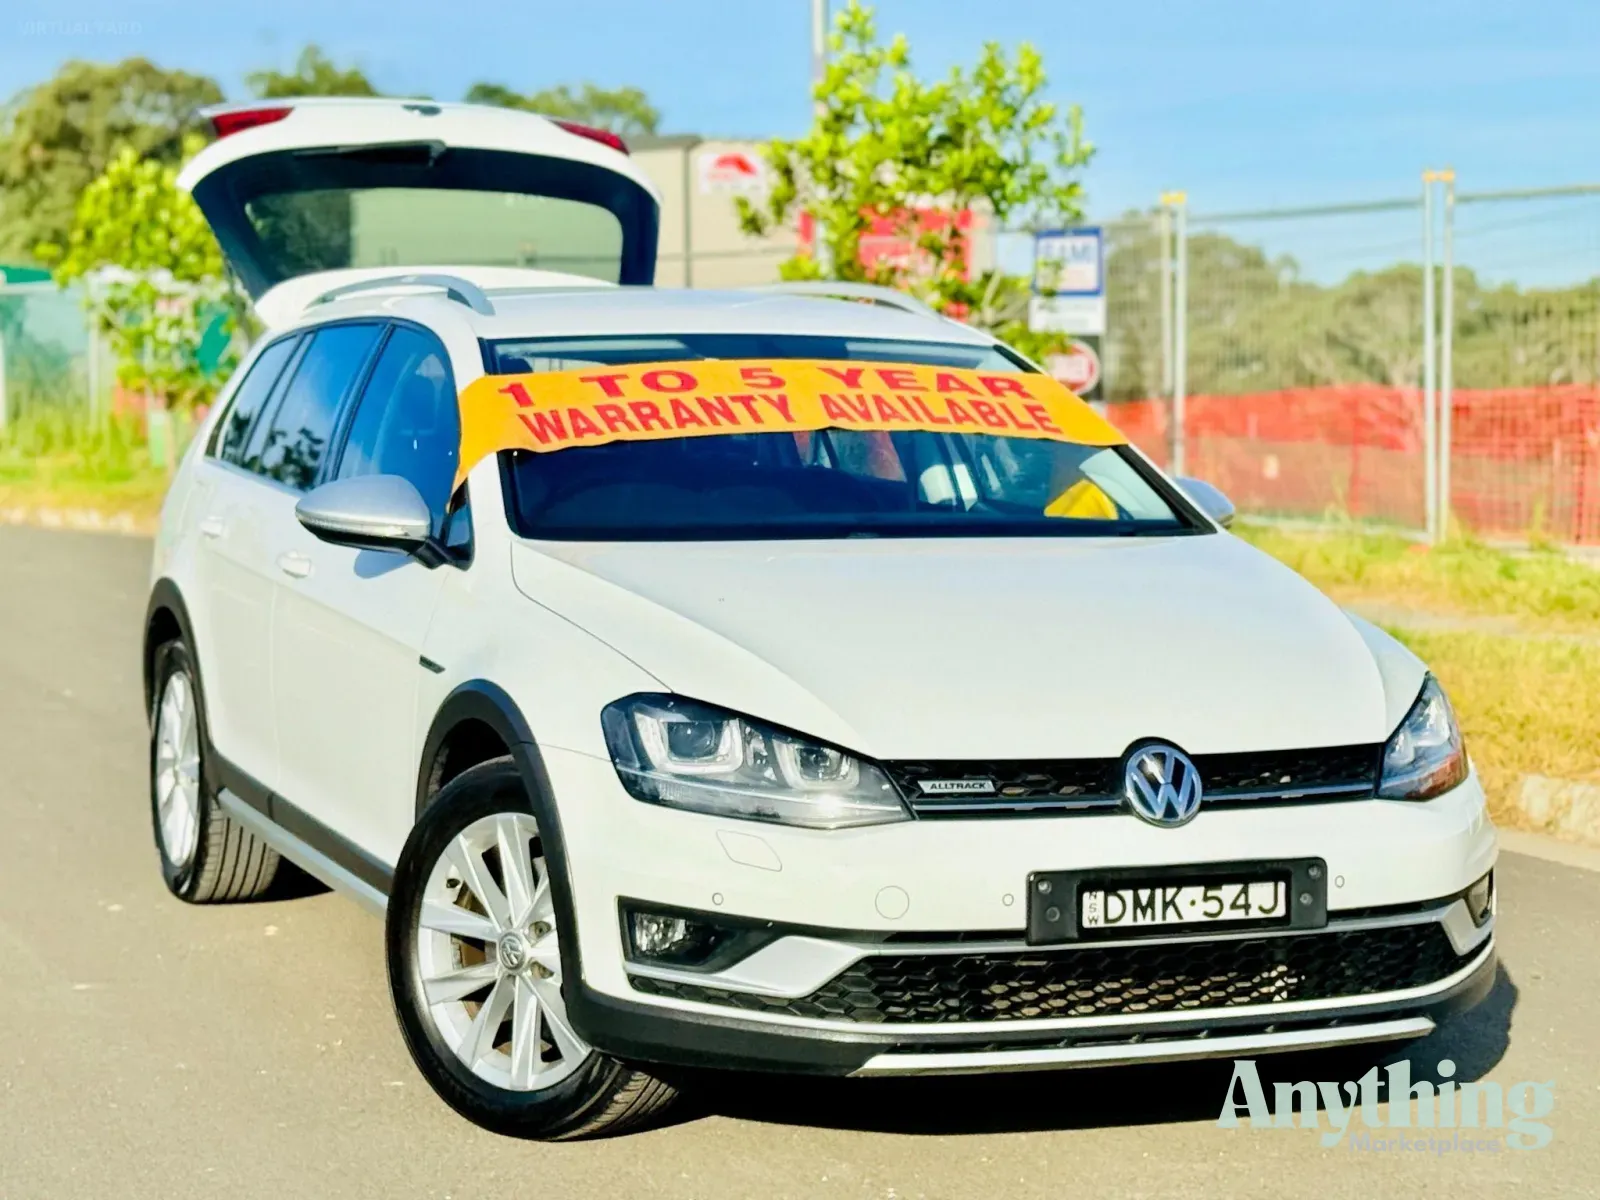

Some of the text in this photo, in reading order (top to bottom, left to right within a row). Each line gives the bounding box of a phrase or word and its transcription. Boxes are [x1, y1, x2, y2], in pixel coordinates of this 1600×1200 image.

[498, 382, 535, 408] 1
[579, 370, 698, 397] TO
[739, 367, 787, 389] 5
[817, 367, 1038, 400] YEAR
[516, 393, 1063, 445] WARRANTY AVAILABLE
[929, 781, 987, 791] ALLTRACK
